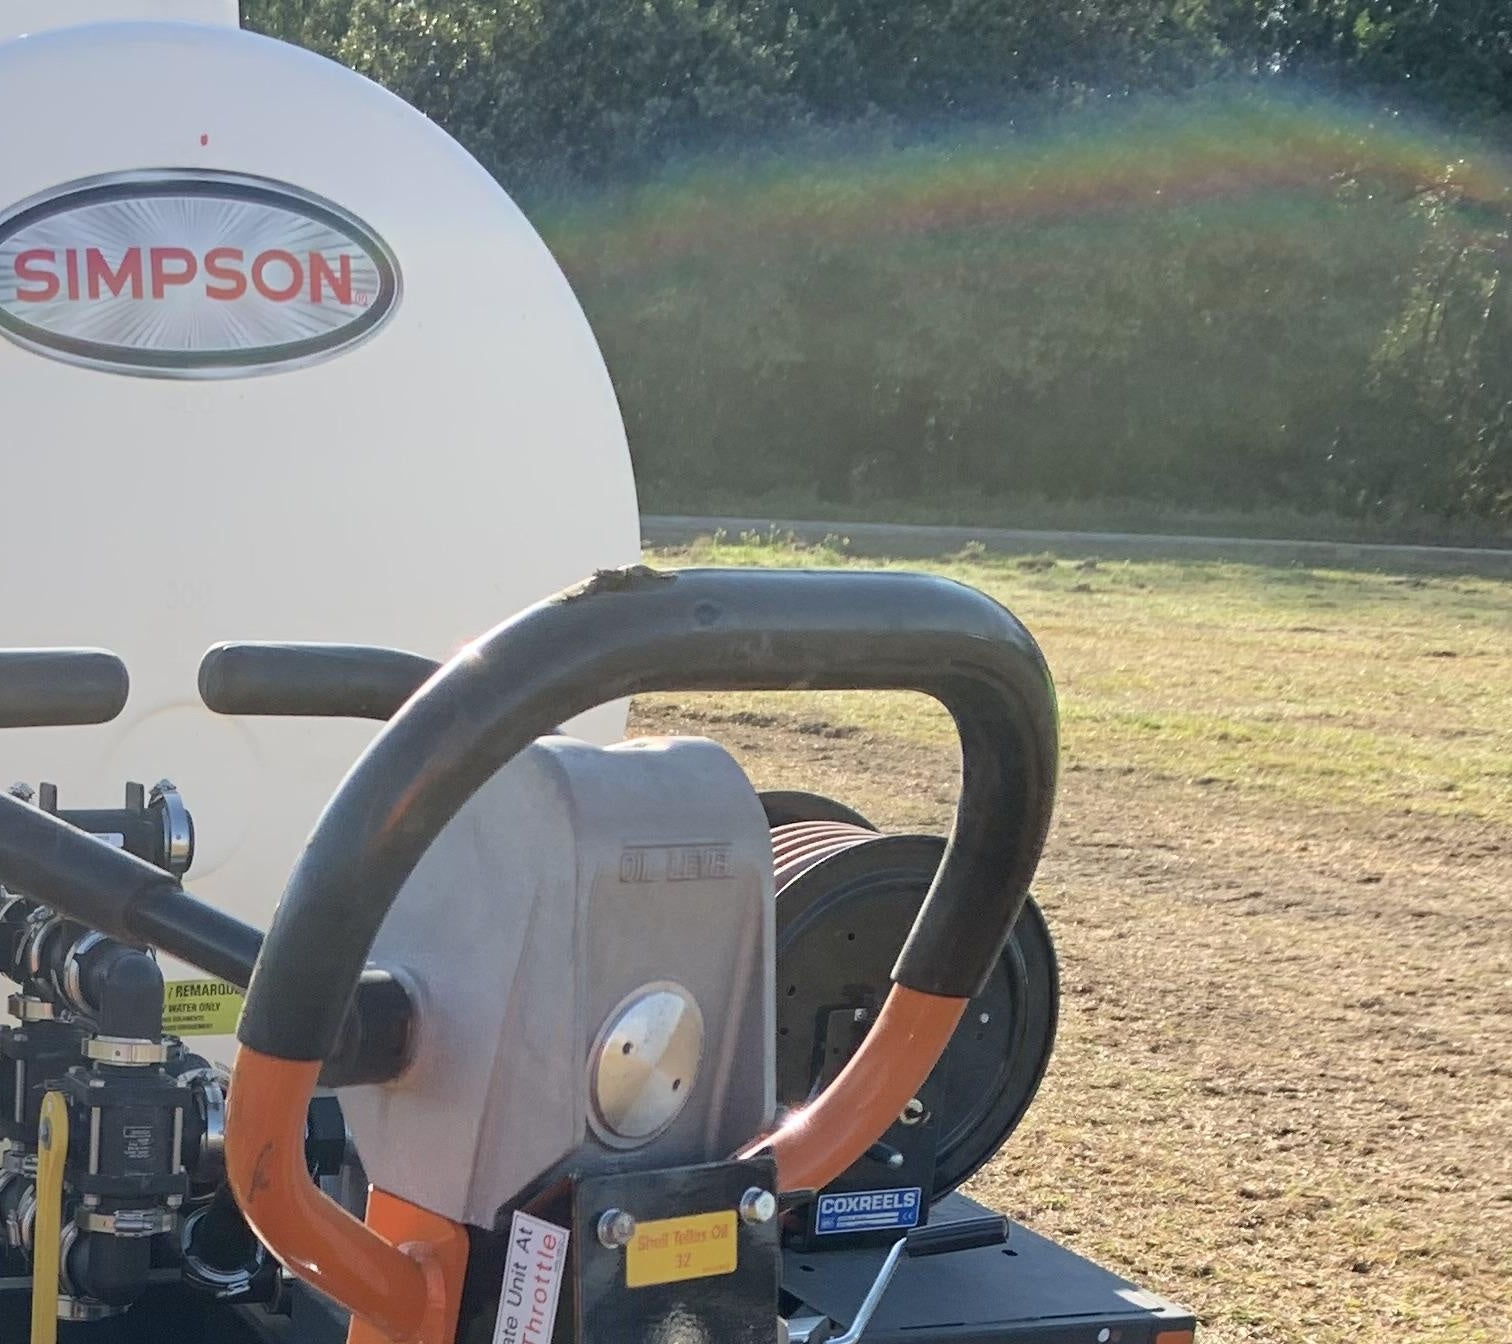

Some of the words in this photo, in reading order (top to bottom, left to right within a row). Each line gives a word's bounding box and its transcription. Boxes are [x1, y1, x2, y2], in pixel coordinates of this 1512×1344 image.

[13, 246, 354, 306] SIMPSON
[176, 984, 240, 998] REMARQU
[168, 1003, 197, 1013] WATER
[198, 1002, 221, 1012] ONLY
[821, 1191, 916, 1215] COXREELS
[516, 1226, 534, 1254] At
[507, 1261, 528, 1307] Unit
